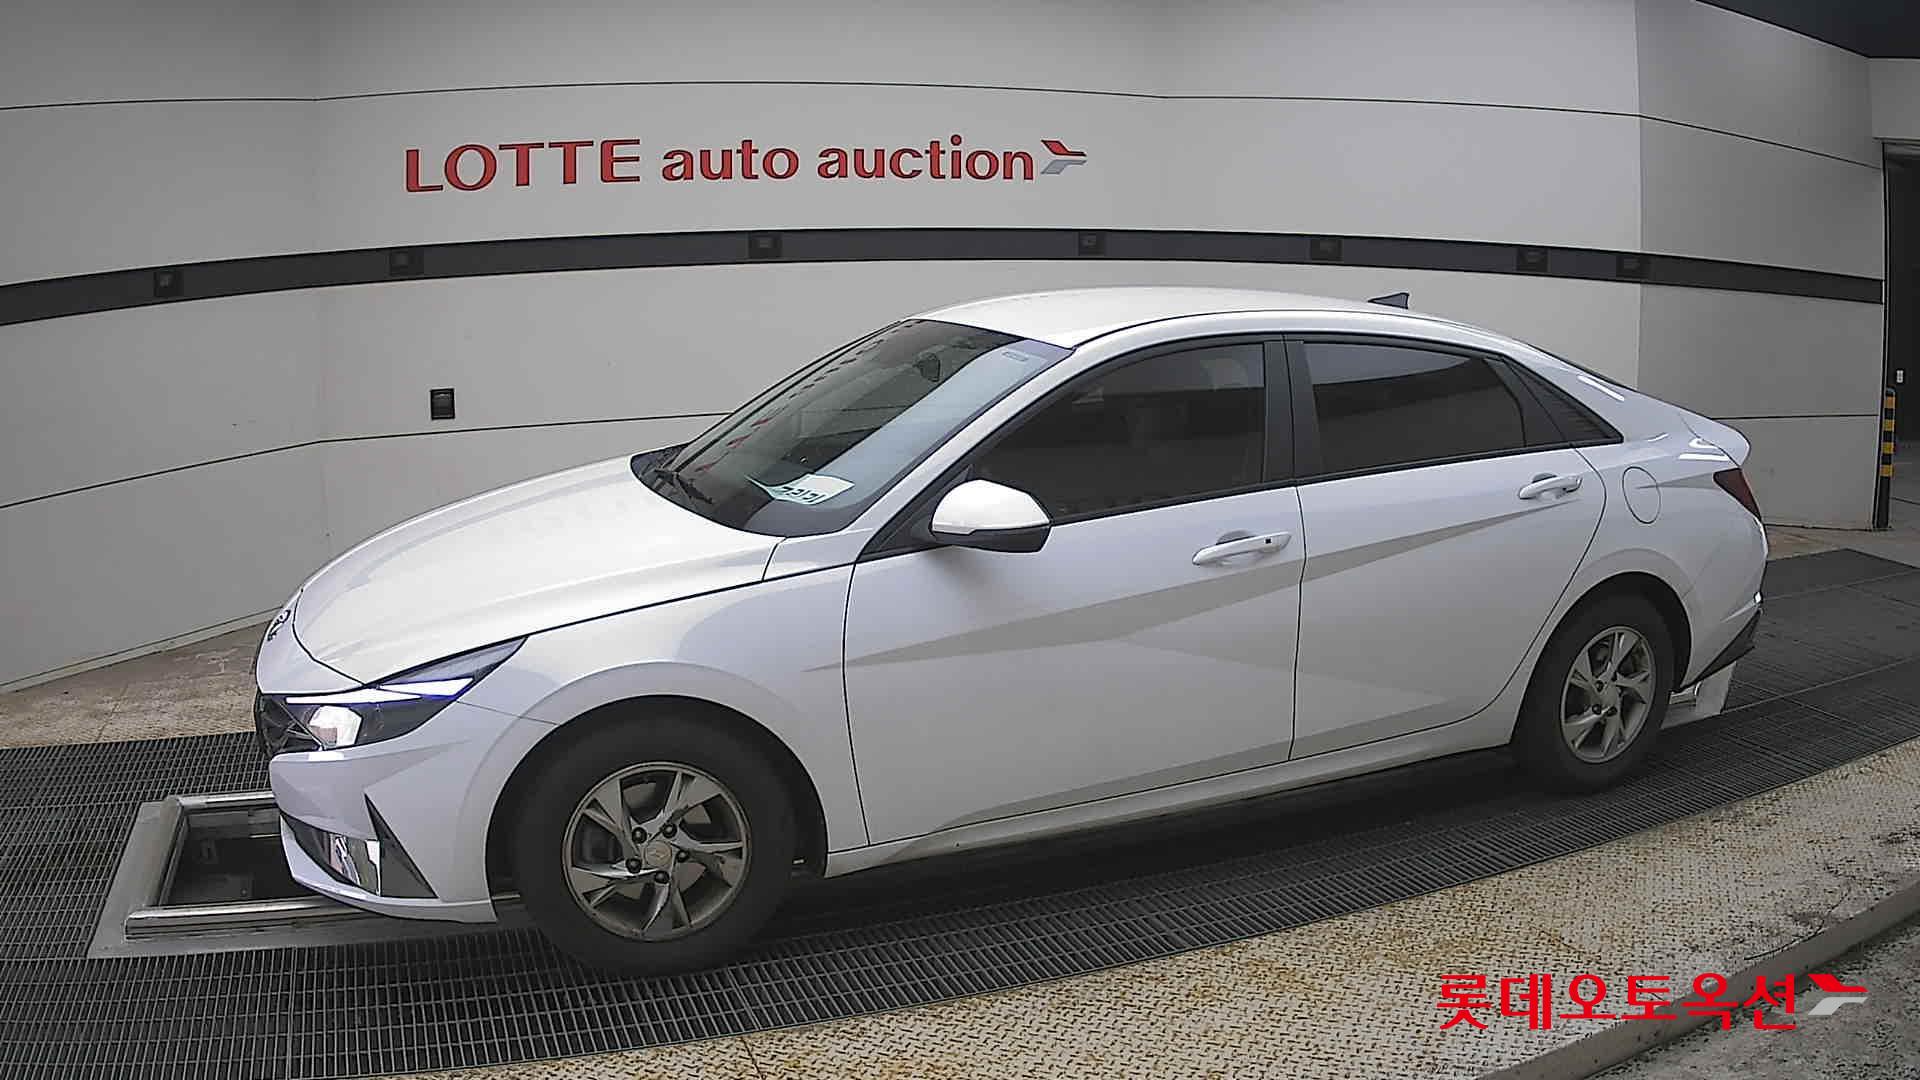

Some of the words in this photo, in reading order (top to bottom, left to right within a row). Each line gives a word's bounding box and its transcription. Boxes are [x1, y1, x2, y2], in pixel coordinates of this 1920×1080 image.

[405, 139, 640, 193] LOTTE
[662, 139, 800, 181] auto
[817, 134, 1034, 181] auction
